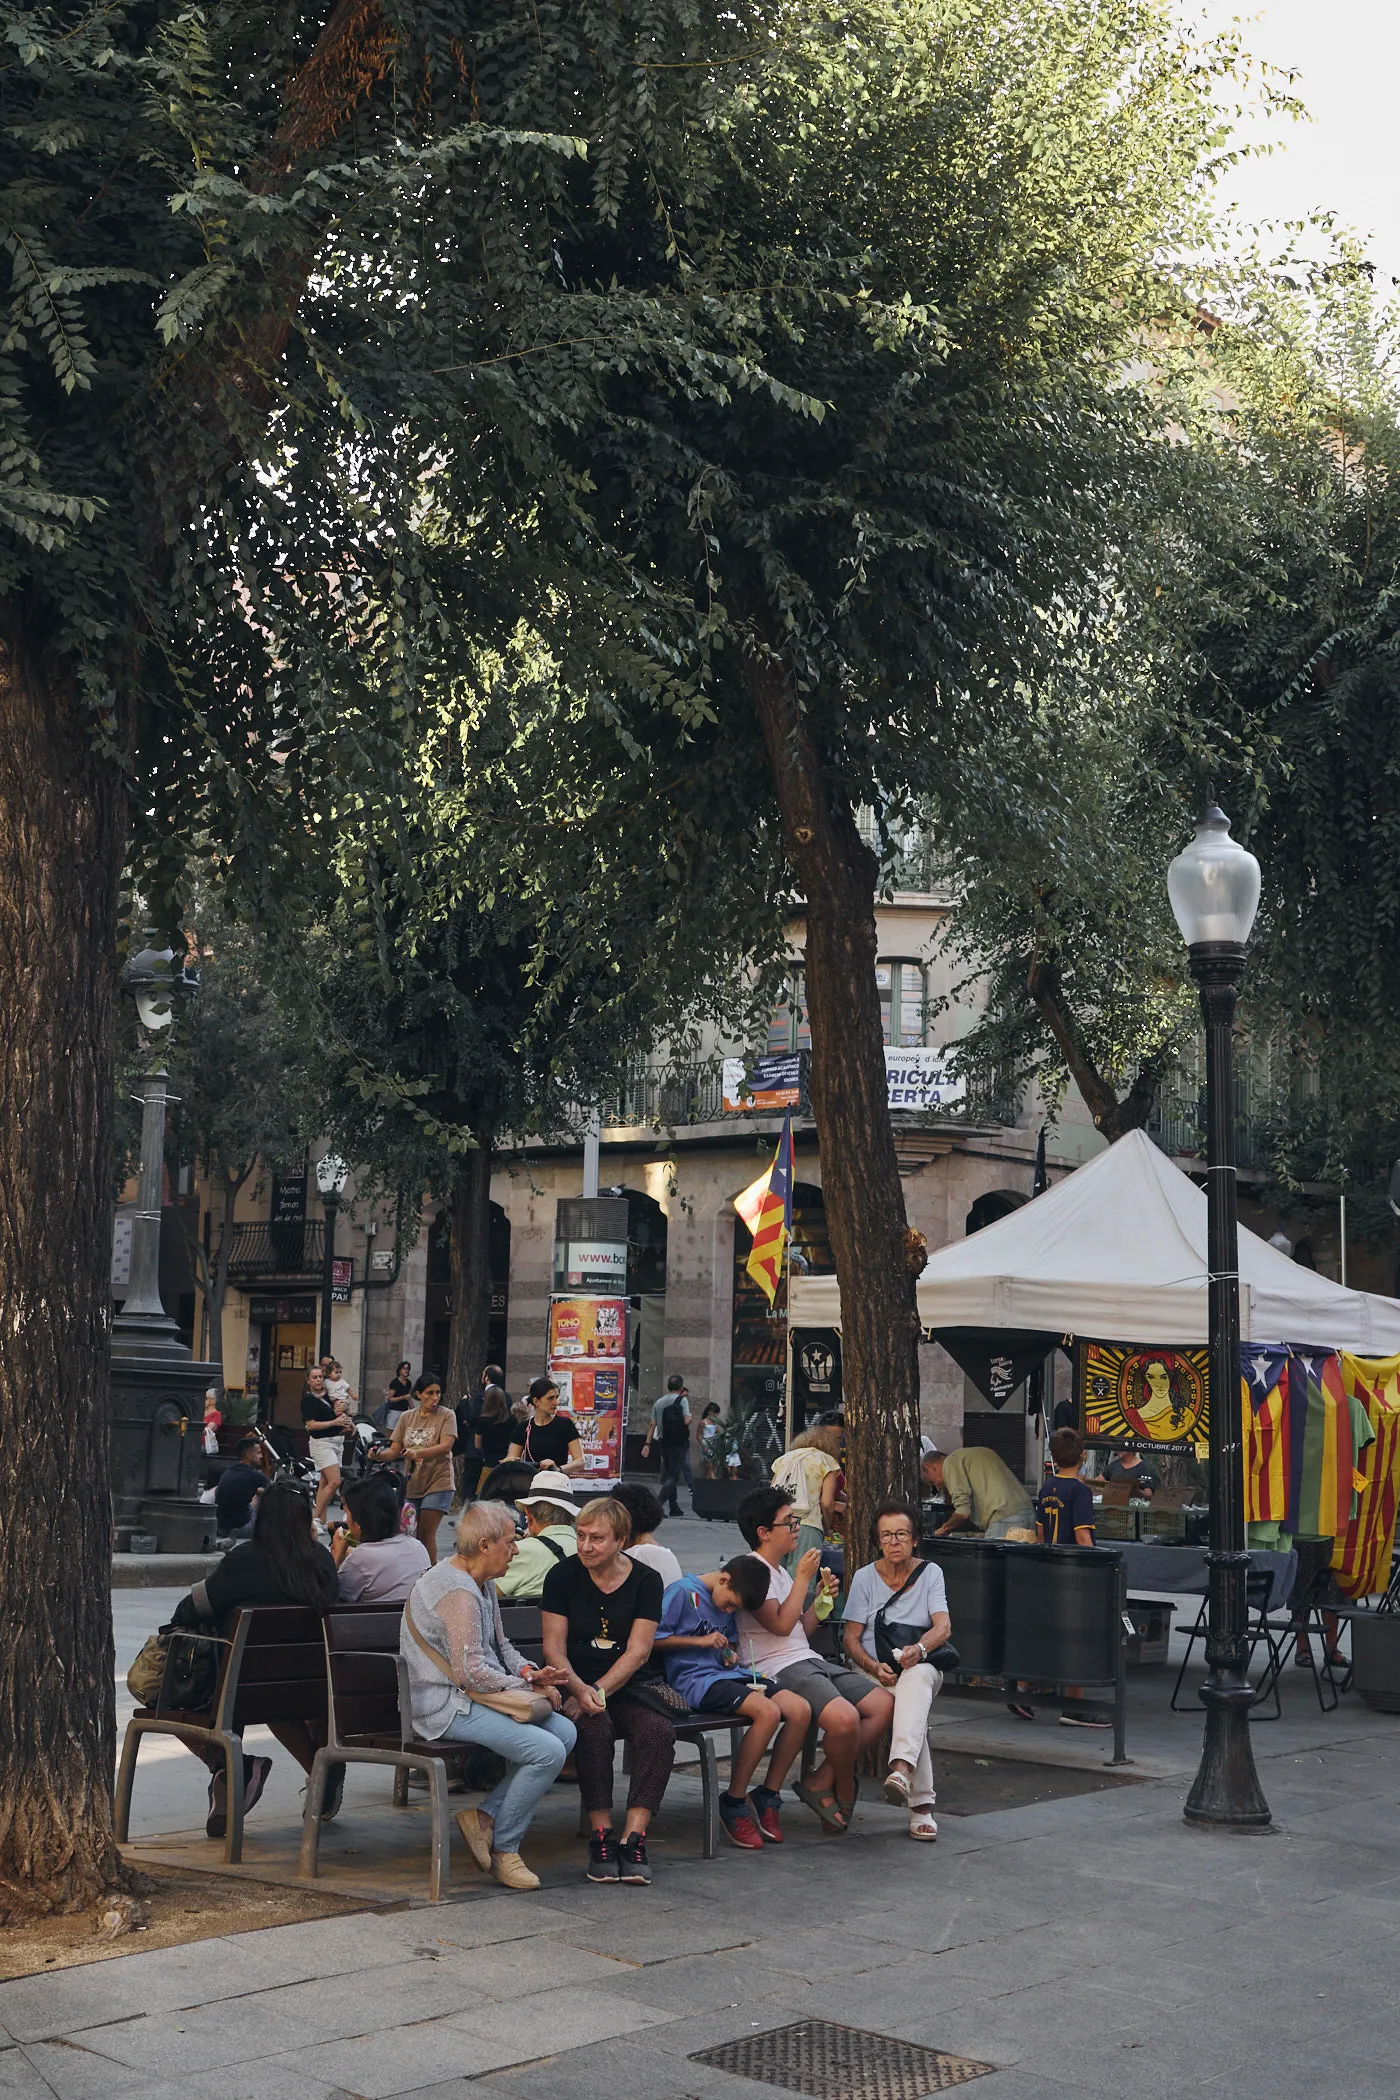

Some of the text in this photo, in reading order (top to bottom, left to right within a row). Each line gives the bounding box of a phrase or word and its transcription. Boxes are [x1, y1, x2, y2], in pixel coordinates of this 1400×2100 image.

[887, 1069, 957, 1086] RICULA
[888, 1089, 941, 1104] ERTA
[766, 1309, 788, 1318] La M
[557, 1317, 580, 1328] TONO
[1171, 1444, 1187, 1452] 2017
